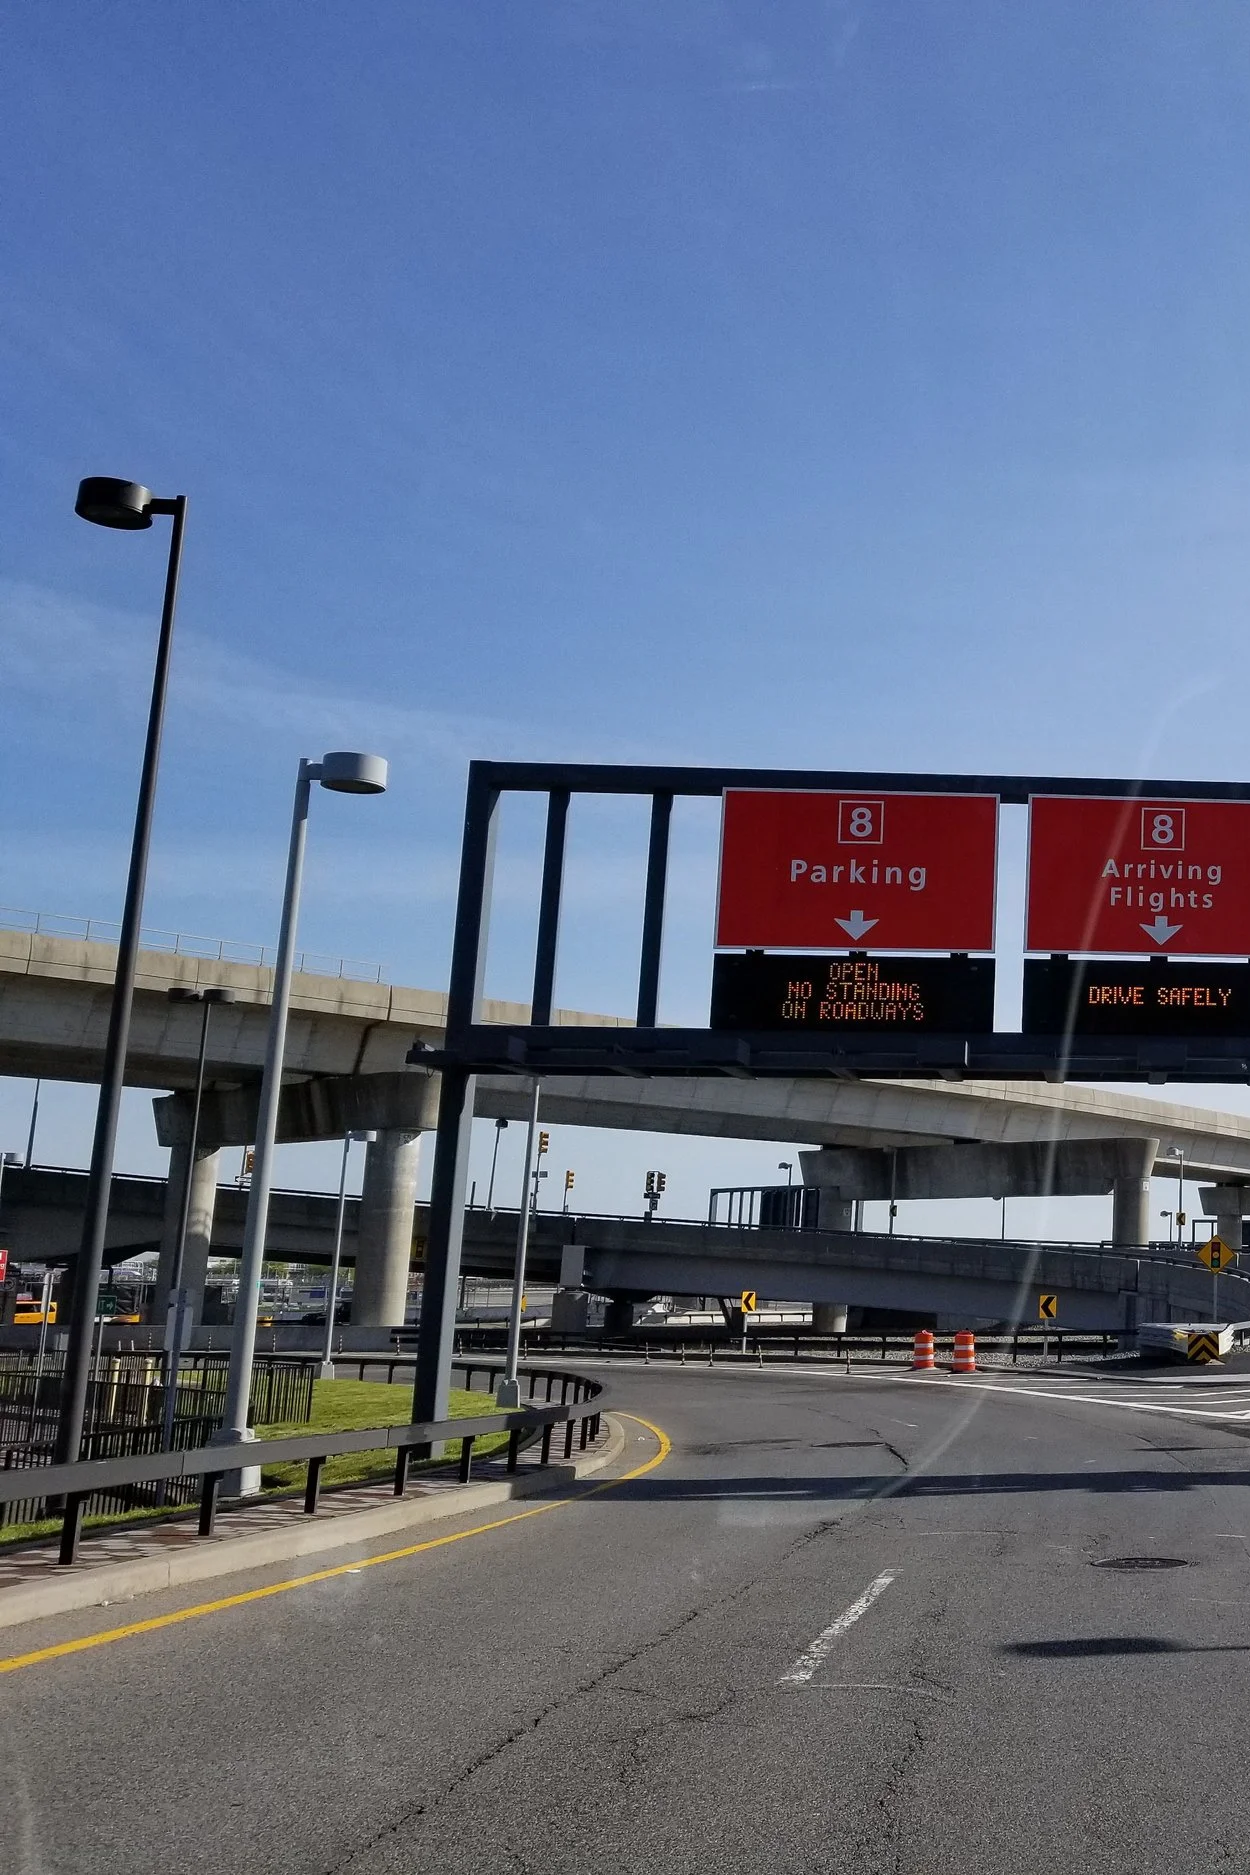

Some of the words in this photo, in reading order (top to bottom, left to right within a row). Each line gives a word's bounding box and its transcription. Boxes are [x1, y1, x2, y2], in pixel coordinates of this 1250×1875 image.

[850, 807, 873, 837] 8
[1151, 814, 1174, 844] 8
[790, 859, 927, 891] Parking
[1101, 858, 1222, 885] Arriving
[1110, 886, 1213, 912] Flights
[829, 962, 879, 981] OPEN
[788, 981, 812, 1000] NO
[826, 982, 920, 1001] STANDING
[1089, 986, 1144, 1005] DRIVE
[1157, 987, 1232, 1006] SAFELY
[781, 1000, 806, 1019] ON
[819, 1001, 924, 1021] ROADWAYS
